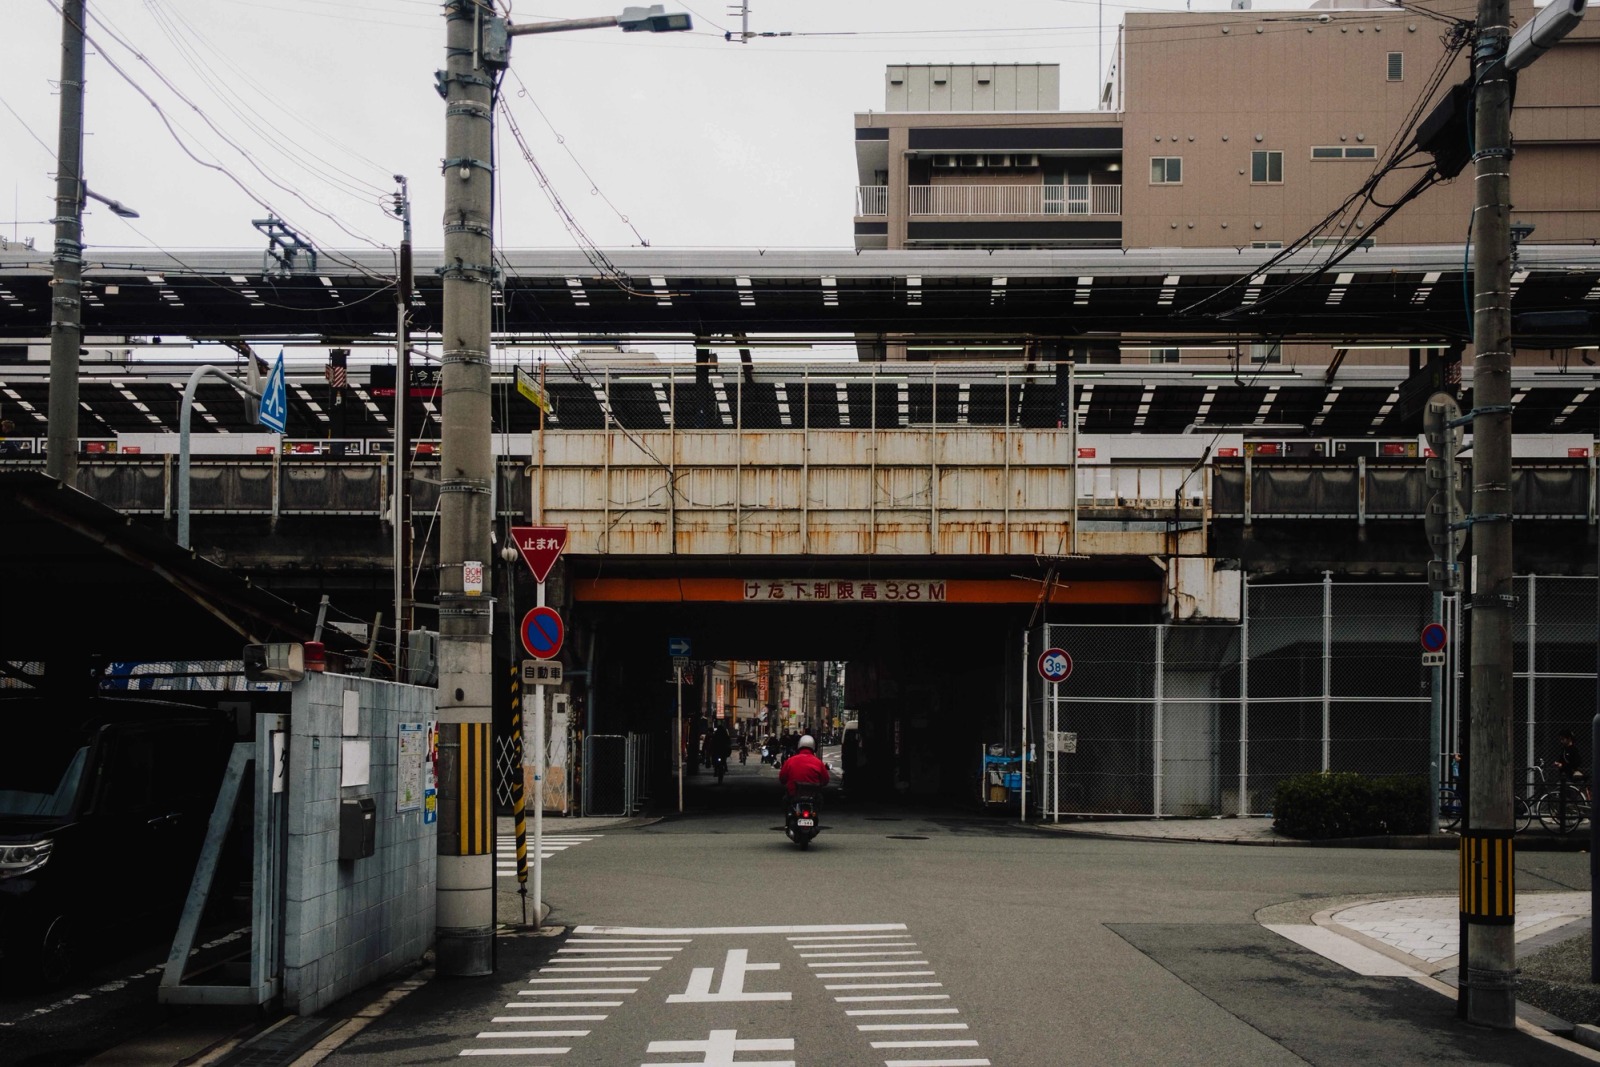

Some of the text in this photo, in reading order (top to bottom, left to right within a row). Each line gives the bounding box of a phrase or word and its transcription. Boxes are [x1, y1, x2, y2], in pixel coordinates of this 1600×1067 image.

[522, 537, 560, 552] 止まれ
[465, 576, 482, 584] 825
[1423, 655, 1444, 664] 自動車
[524, 666, 561, 680] 自動車
